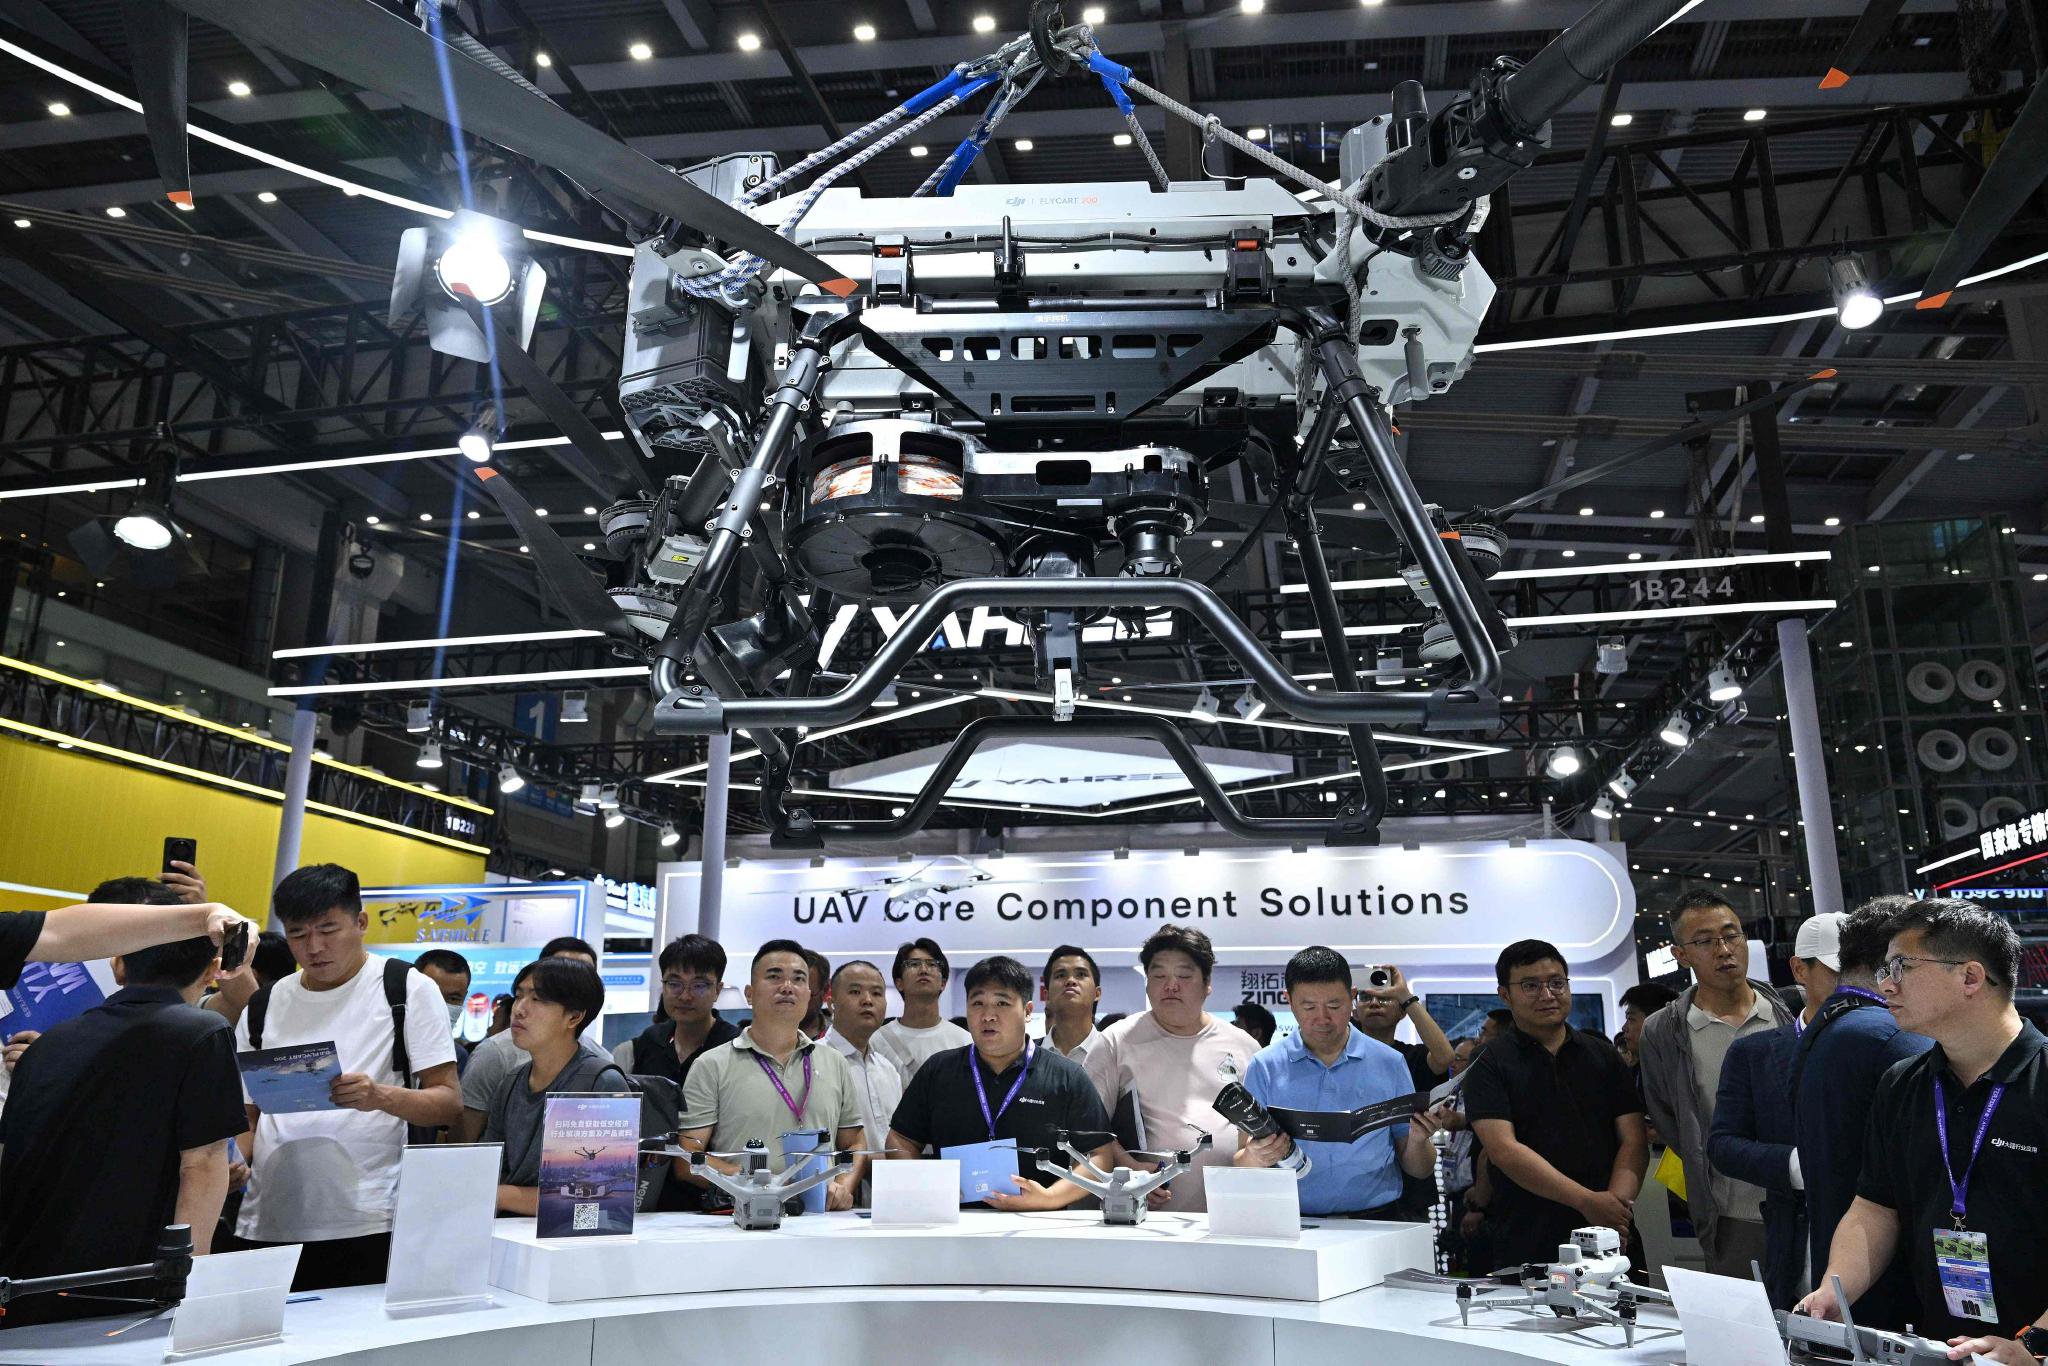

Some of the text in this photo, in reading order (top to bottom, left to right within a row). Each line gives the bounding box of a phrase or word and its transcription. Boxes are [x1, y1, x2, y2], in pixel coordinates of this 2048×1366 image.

[1039, 197, 1078, 206] FLYCART
[1629, 575, 1735, 601] 1B244
[1980, 808, 2048, 861] 国家级专精
[793, 884, 1470, 927] UAV Core Component Solutions
